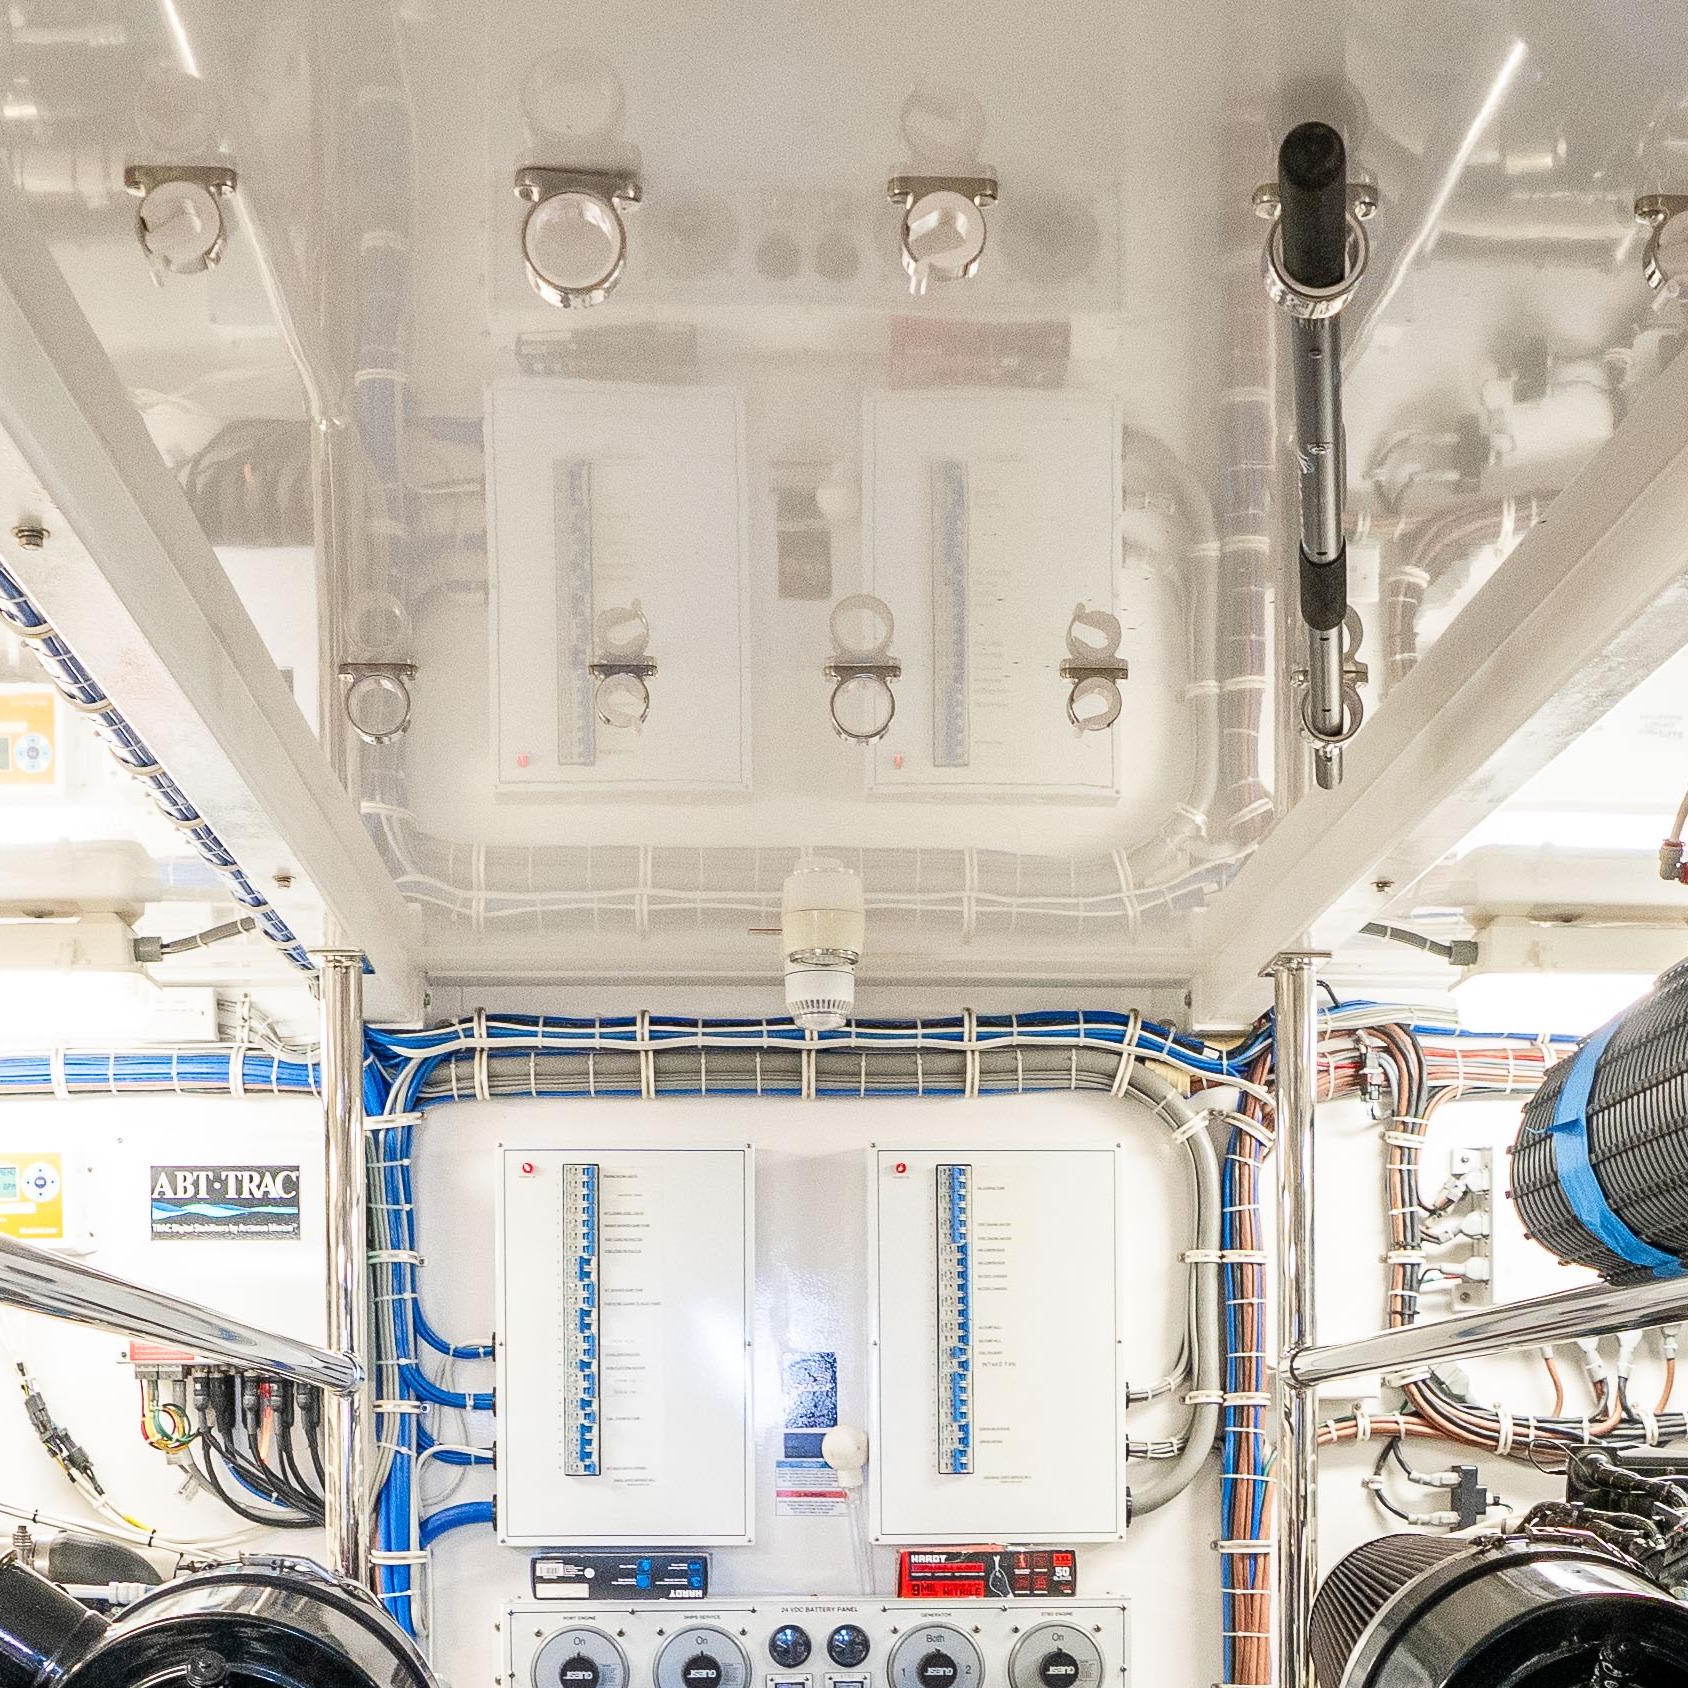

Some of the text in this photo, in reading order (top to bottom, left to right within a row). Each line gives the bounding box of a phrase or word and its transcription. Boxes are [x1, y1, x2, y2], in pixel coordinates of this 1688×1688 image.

[911, 1554, 947, 1562] HARDY
[1055, 1567, 1069, 1577] 50
[669, 1589, 703, 1599] HARDY
[573, 1636, 586, 1646] On
[695, 1636, 708, 1646] On
[926, 1633, 945, 1643] Both
[1052, 1632, 1065, 1642] On
[965, 1665, 972, 1675] 2
